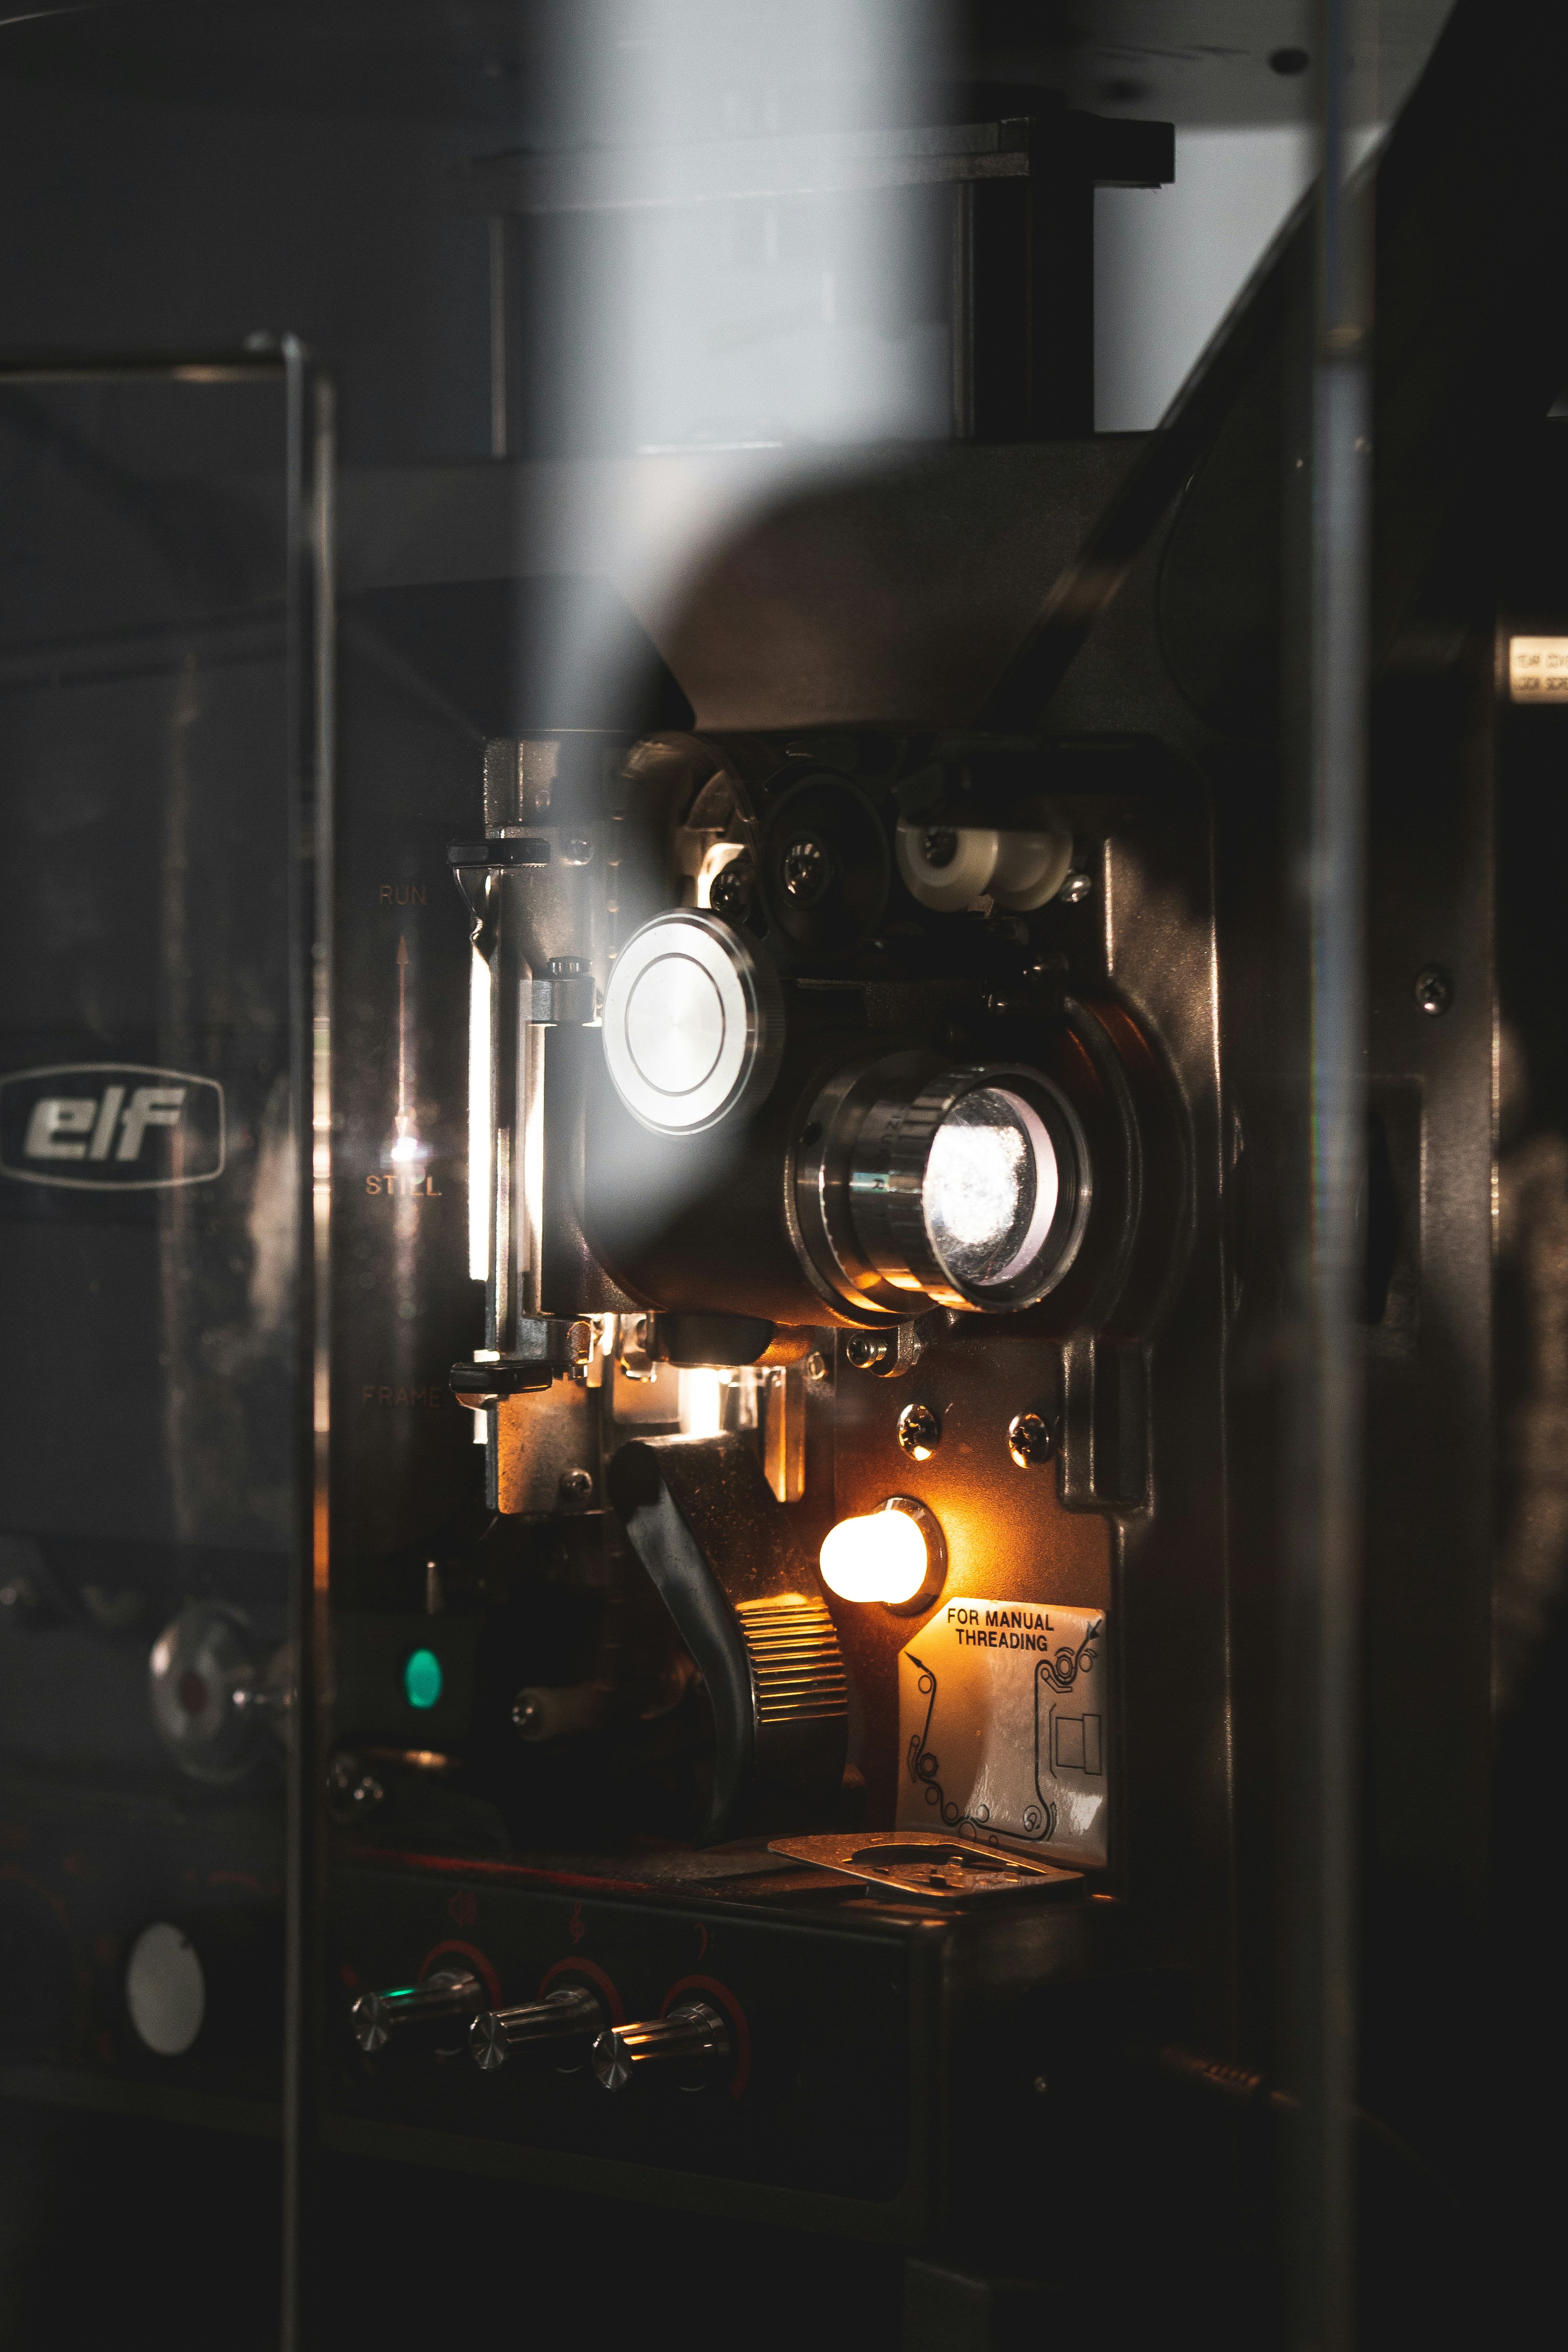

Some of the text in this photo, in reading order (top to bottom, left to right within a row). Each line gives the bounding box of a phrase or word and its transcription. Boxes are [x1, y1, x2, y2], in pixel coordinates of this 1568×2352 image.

[379, 885, 428, 905] RUN
[23, 1084, 187, 1162] elf
[362, 1385, 441, 1408] FRAME
[947, 1608, 1054, 1631] FOR MANUAL
[955, 1628, 1048, 1652] THREADING
